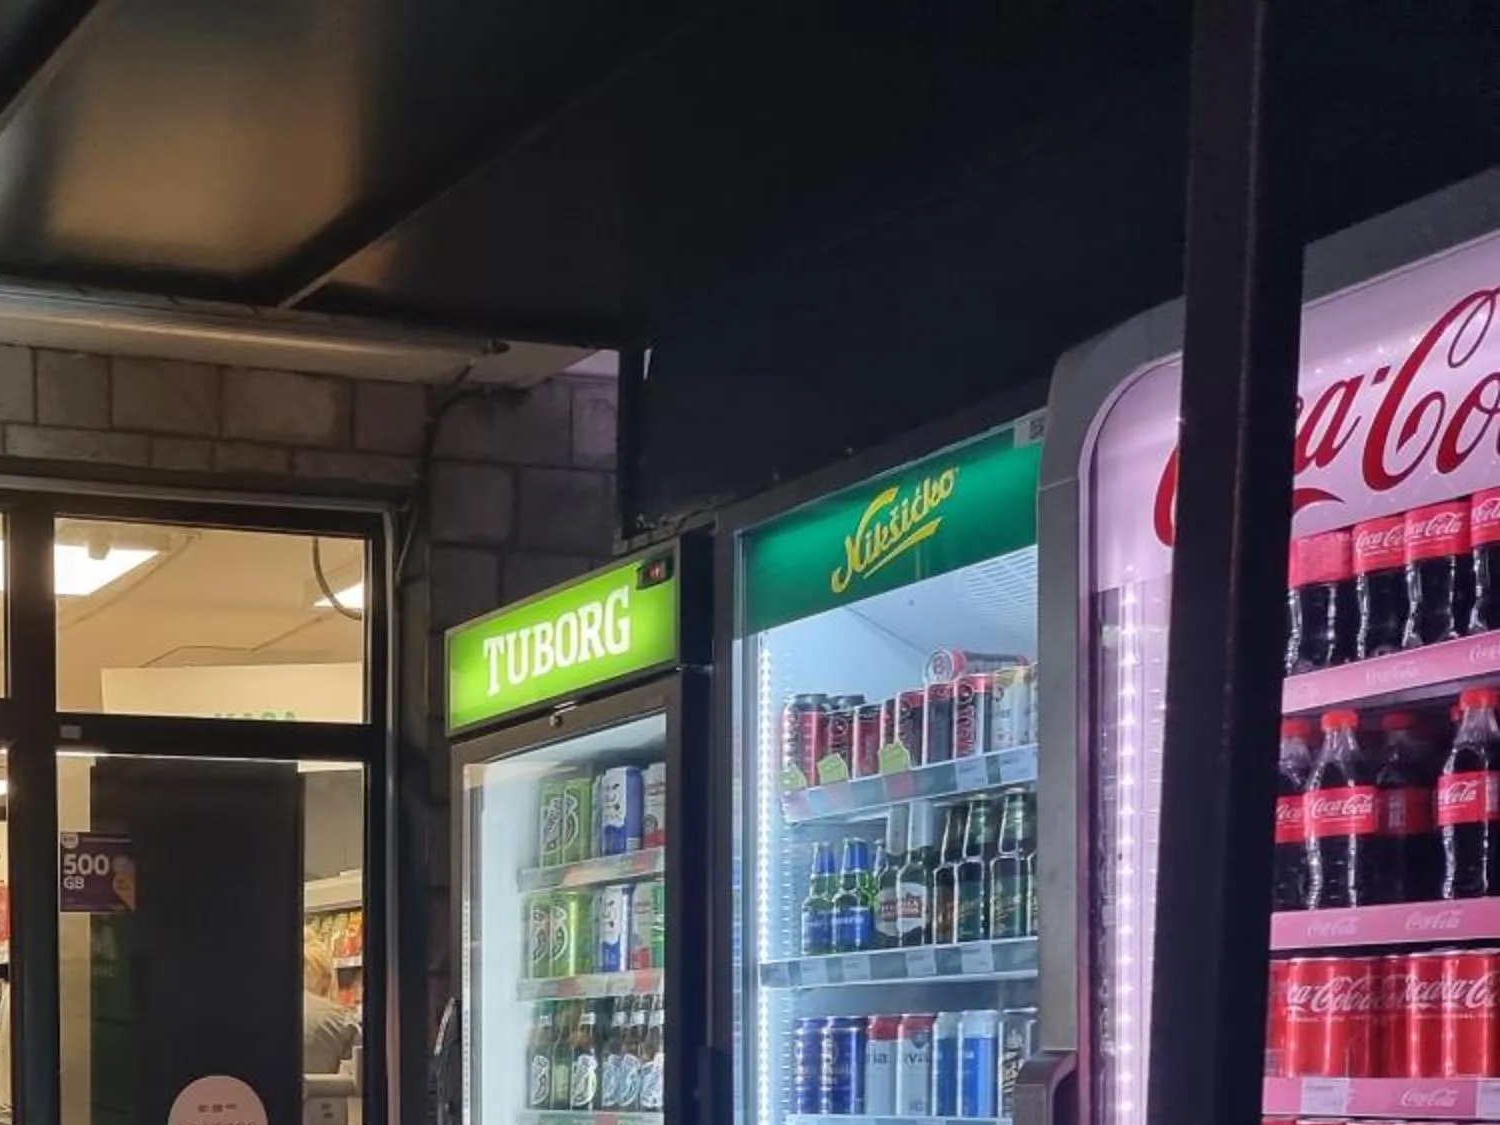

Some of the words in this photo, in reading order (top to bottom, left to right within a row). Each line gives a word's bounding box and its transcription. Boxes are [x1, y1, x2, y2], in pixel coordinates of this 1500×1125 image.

[483, 585, 631, 695] TUBORG
[63, 853, 109, 875] 500
[63, 876, 85, 890] GB
